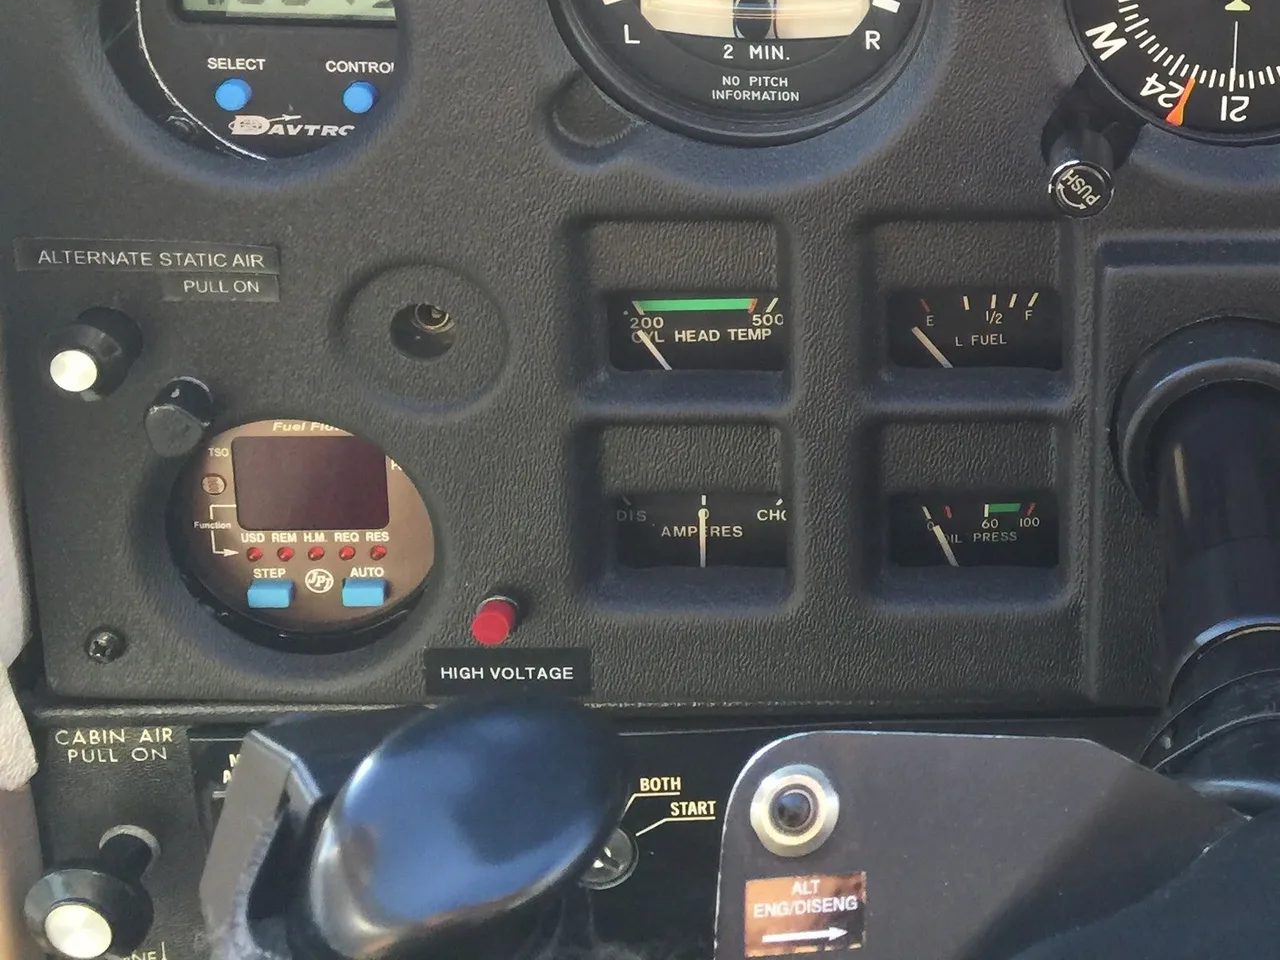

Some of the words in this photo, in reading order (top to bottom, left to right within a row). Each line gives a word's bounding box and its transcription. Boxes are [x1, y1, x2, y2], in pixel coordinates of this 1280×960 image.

[723, 45, 734, 59] 2
[749, 45, 791, 60] MIN.
[207, 58, 266, 70] SELECT
[722, 75, 740, 87] NO
[749, 76, 788, 87] PITCH
[712, 89, 800, 102] INFORMATION
[1062, 169, 1101, 206] PUSH
[38, 250, 152, 266] ALTERNATE
[160, 253, 227, 268] STATIC
[232, 254, 265, 268] AIR
[184, 280, 229, 293] PULL
[233, 280, 260, 293] ON
[630, 317, 664, 329] 200
[675, 330, 720, 343] HEAD
[728, 328, 772, 341] TEMP
[955, 336, 963, 347] L
[971, 334, 1007, 346] FUEL
[194, 521, 231, 530] Function
[1019, 517, 1040, 528] 100
[272, 533, 297, 543] REM
[366, 531, 389, 542] RES
[253, 568, 286, 579] STEP
[350, 567, 384, 578] AUTO
[441, 667, 484, 680] HIGH
[490, 667, 574, 680] VOLTAGE
[55, 728, 126, 746] CABIN
[140, 728, 173, 743] AIR
[68, 748, 118, 763] PULL
[131, 747, 167, 761] ON
[640, 777, 681, 791] BOTH
[671, 801, 716, 816] START
[791, 880, 820, 896] ALT
[753, 896, 858, 919] ENG/DISENG
